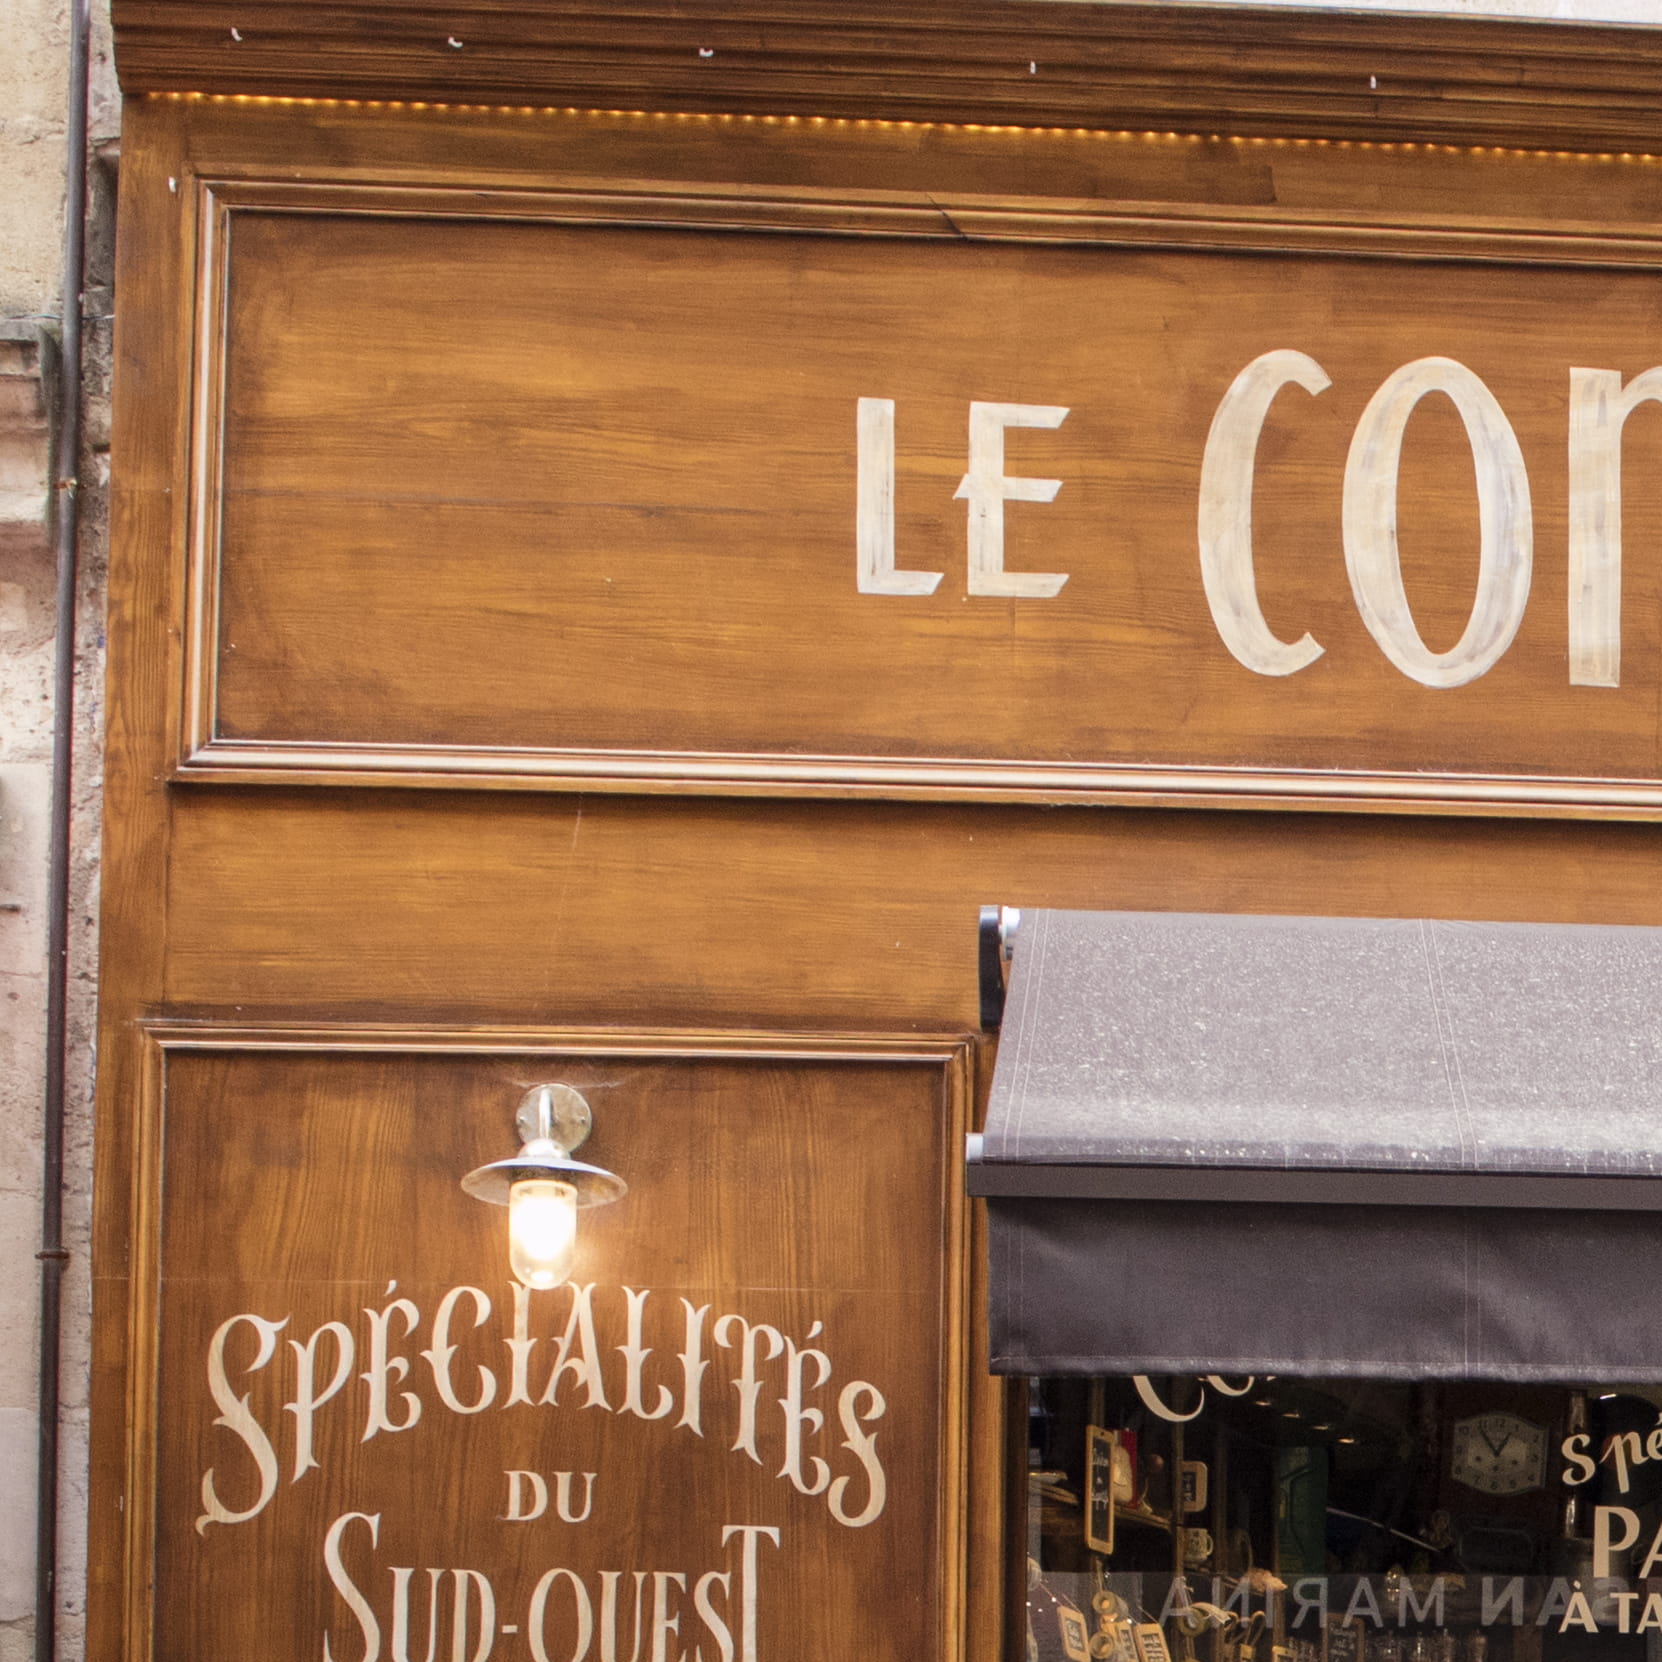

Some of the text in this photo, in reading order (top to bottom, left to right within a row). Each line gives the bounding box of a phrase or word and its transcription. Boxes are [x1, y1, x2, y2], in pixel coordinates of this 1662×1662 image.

[856, 397, 1071, 600] LE
[196, 1279, 887, 1535] SPÉCIALITÉS
[498, 1470, 599, 1525] DU
[1559, 1582, 1599, 1634] À
